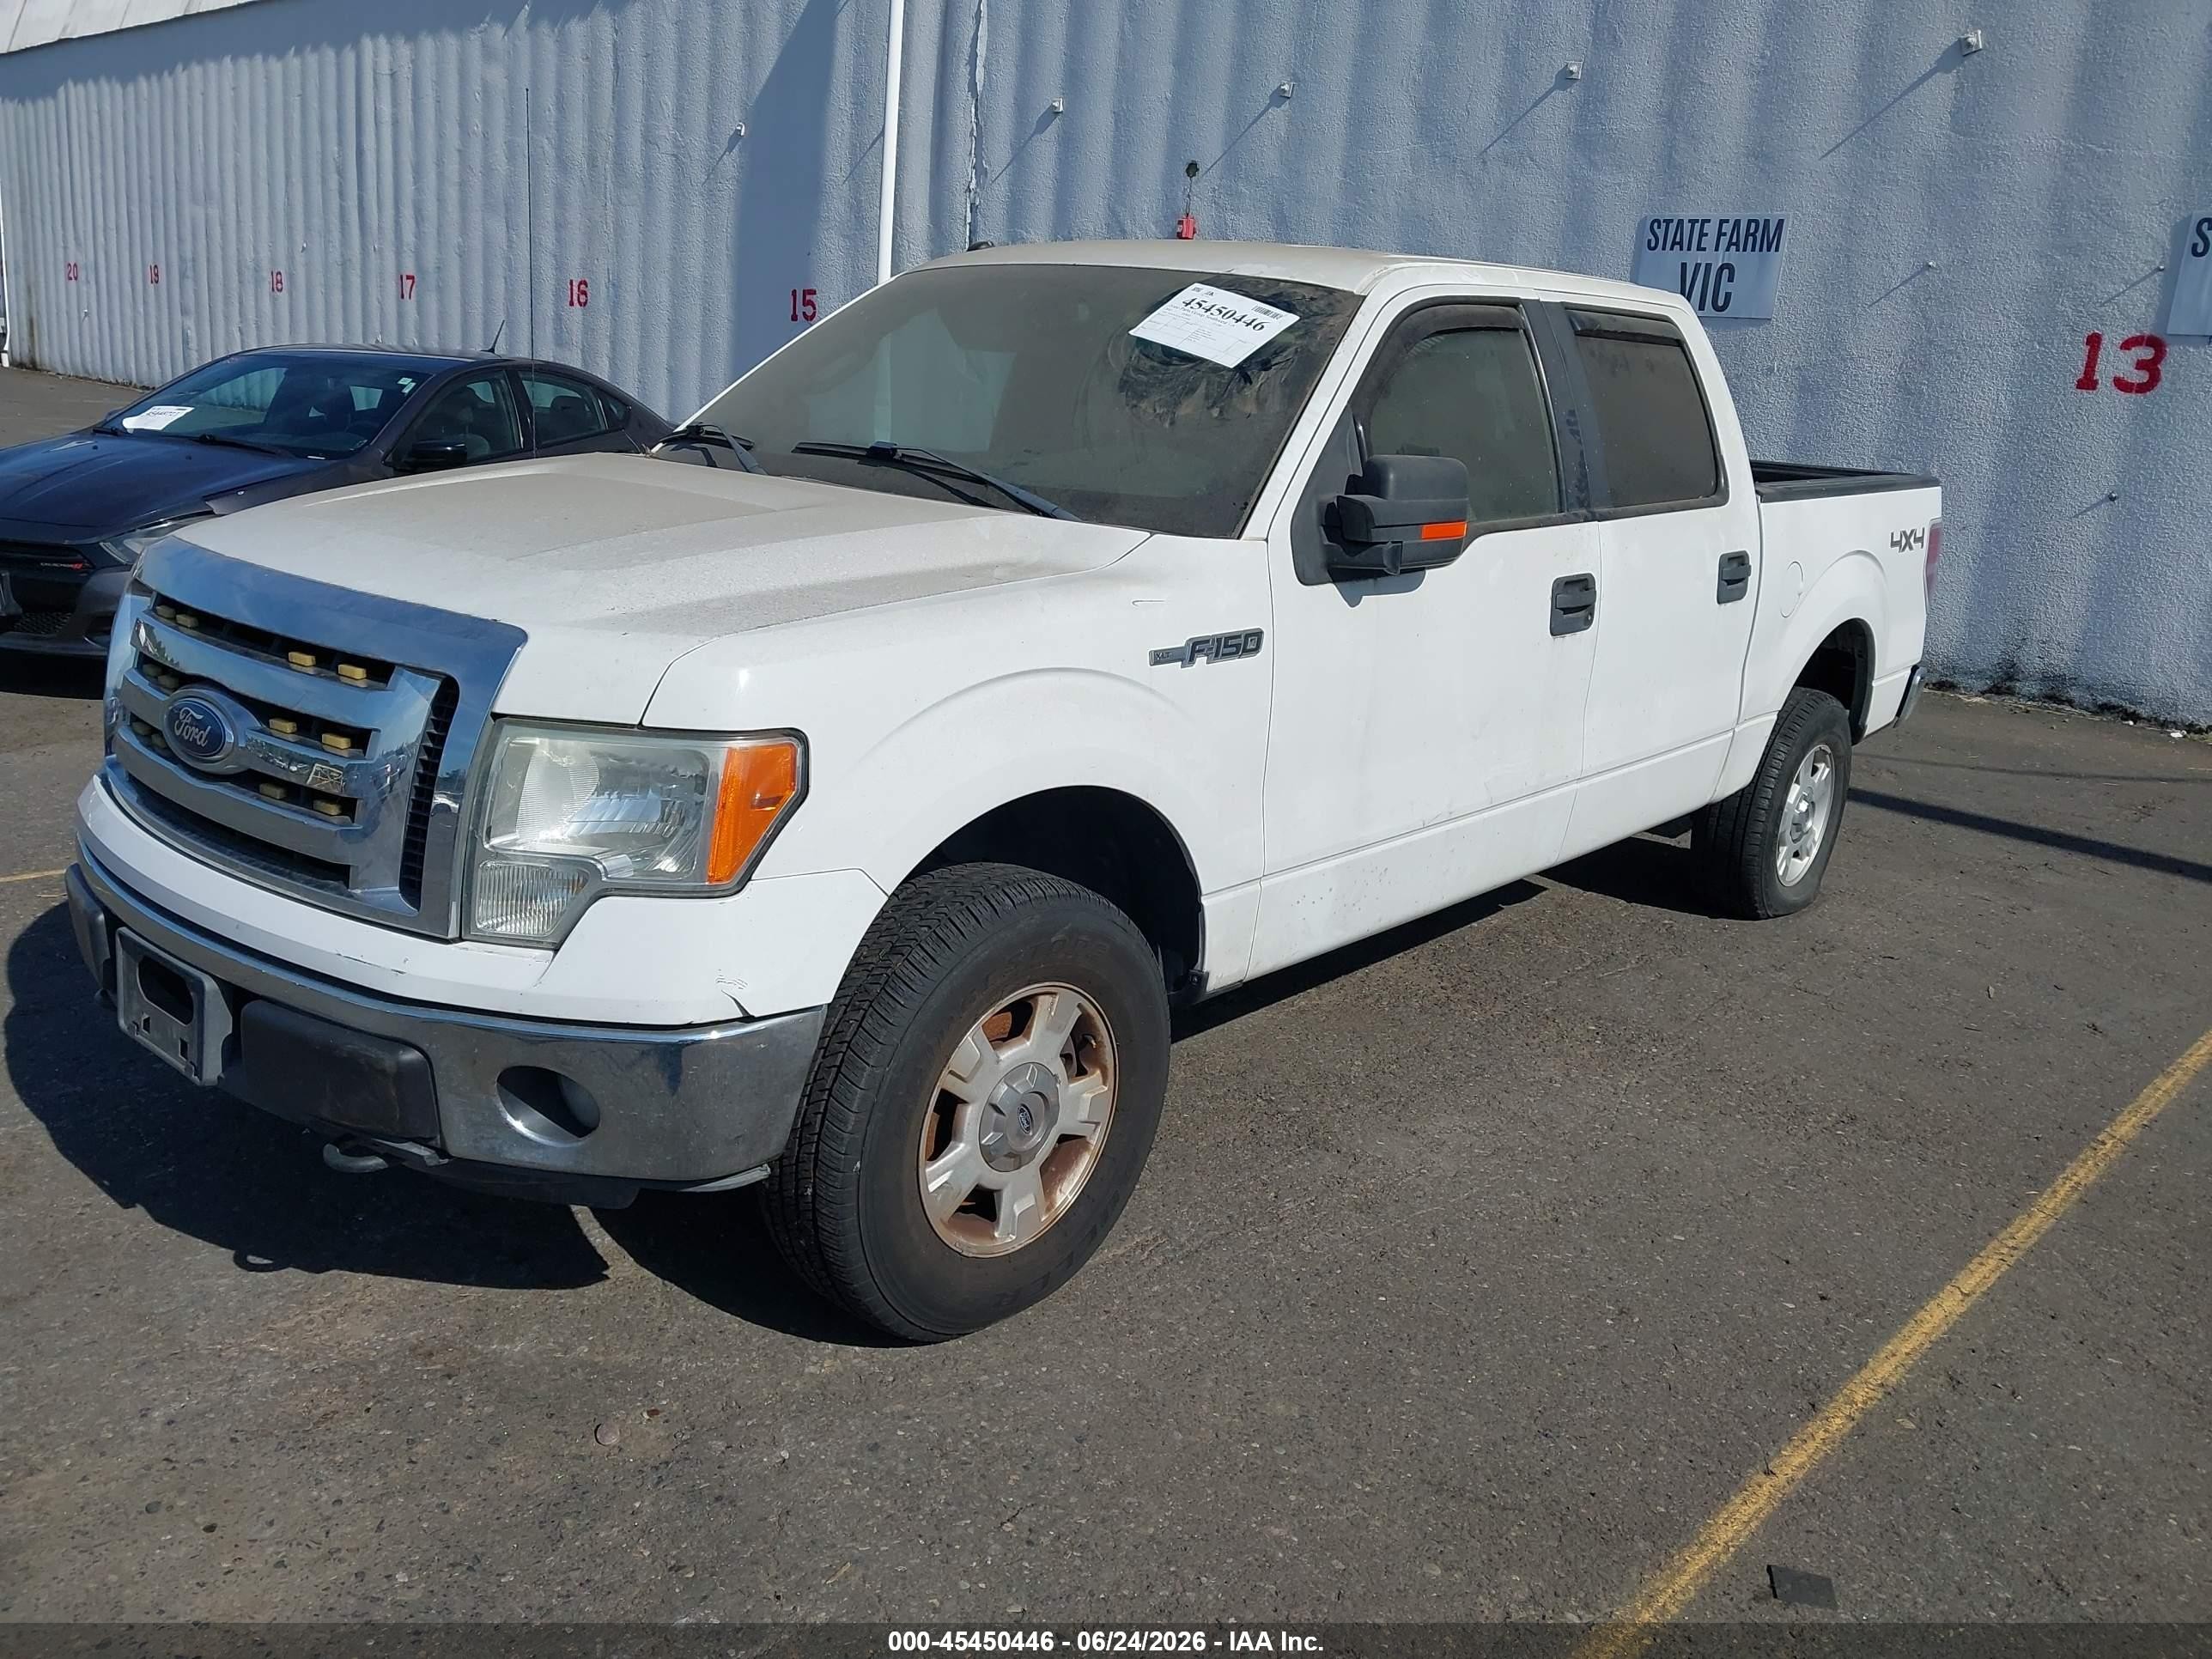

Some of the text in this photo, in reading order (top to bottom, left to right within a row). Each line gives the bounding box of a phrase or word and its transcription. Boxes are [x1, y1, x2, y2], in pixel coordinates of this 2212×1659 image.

[1647, 218, 1785, 252] STATE FARM
[67, 262, 78, 282] 20
[270, 270, 283, 293] 18
[399, 274, 416, 301] 17
[1680, 261, 1735, 313] VIC
[568, 278, 590, 308] 16
[791, 289, 817, 322] 15
[1182, 297, 1271, 331] 45450446
[2075, 331, 2168, 395] 13
[174, 707, 212, 748] Ford
